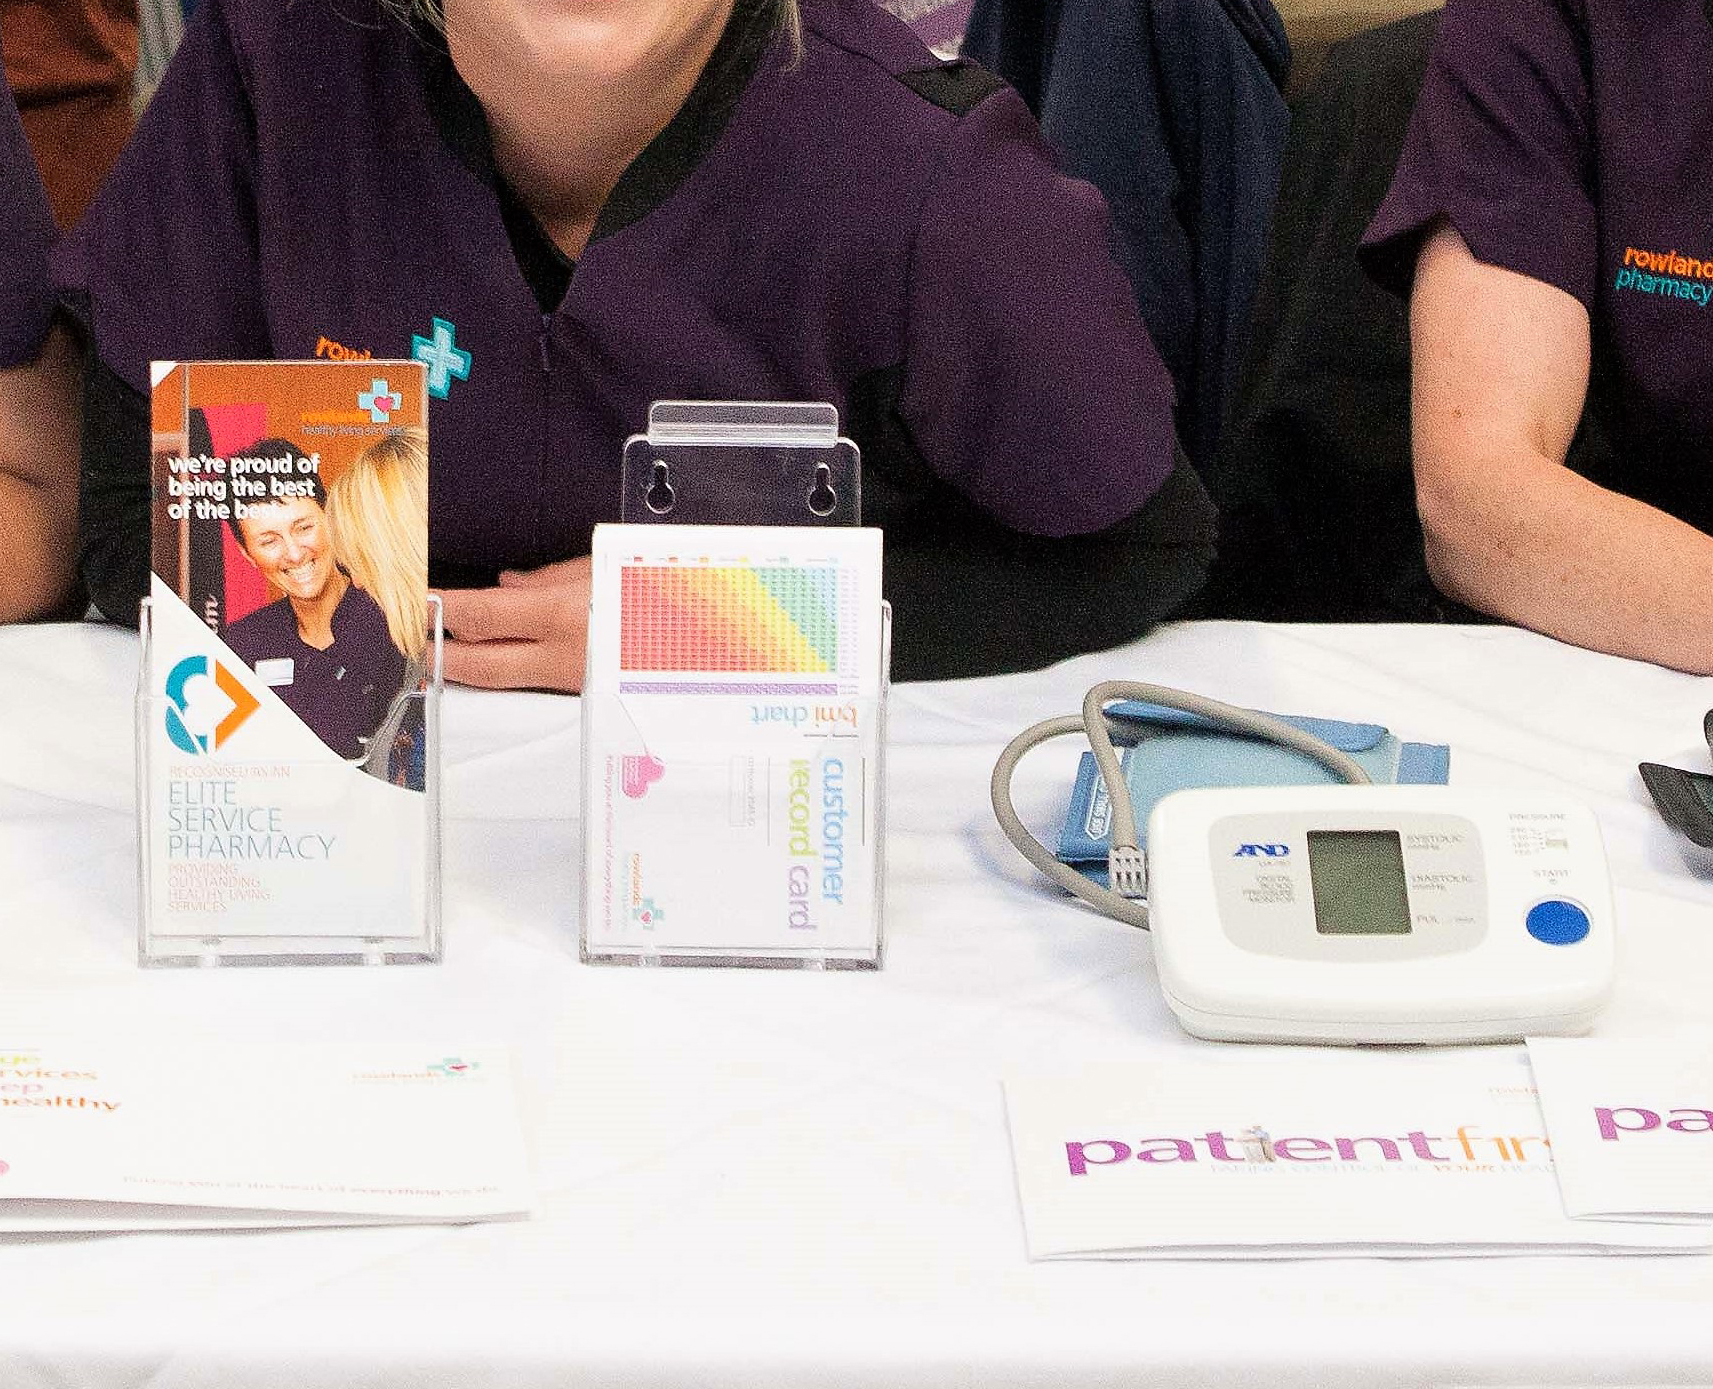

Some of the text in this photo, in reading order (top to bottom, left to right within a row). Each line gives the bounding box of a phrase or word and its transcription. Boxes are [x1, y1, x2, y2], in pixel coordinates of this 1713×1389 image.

[168, 452, 320, 479] we're proud of
[168, 475, 316, 501] being the best
[168, 497, 192, 520] of
[195, 498, 231, 520] the
[749, 703, 859, 728] bmi chart
[169, 765, 247, 778] RECOGNISED
[272, 765, 291, 778] AN
[168, 780, 237, 806] ELITE
[168, 807, 284, 833] SERVICE
[821, 757, 849, 906] customer
[168, 834, 336, 861] PHARMACY
[787, 758, 819, 931] record card
[167, 875, 261, 889] OUTSTANDING
[168, 863, 240, 876] PROVIDING
[168, 889, 227, 902] HEALTHY
[168, 901, 228, 913] SERVICES
[1064, 1125, 1551, 1177] patientfir
